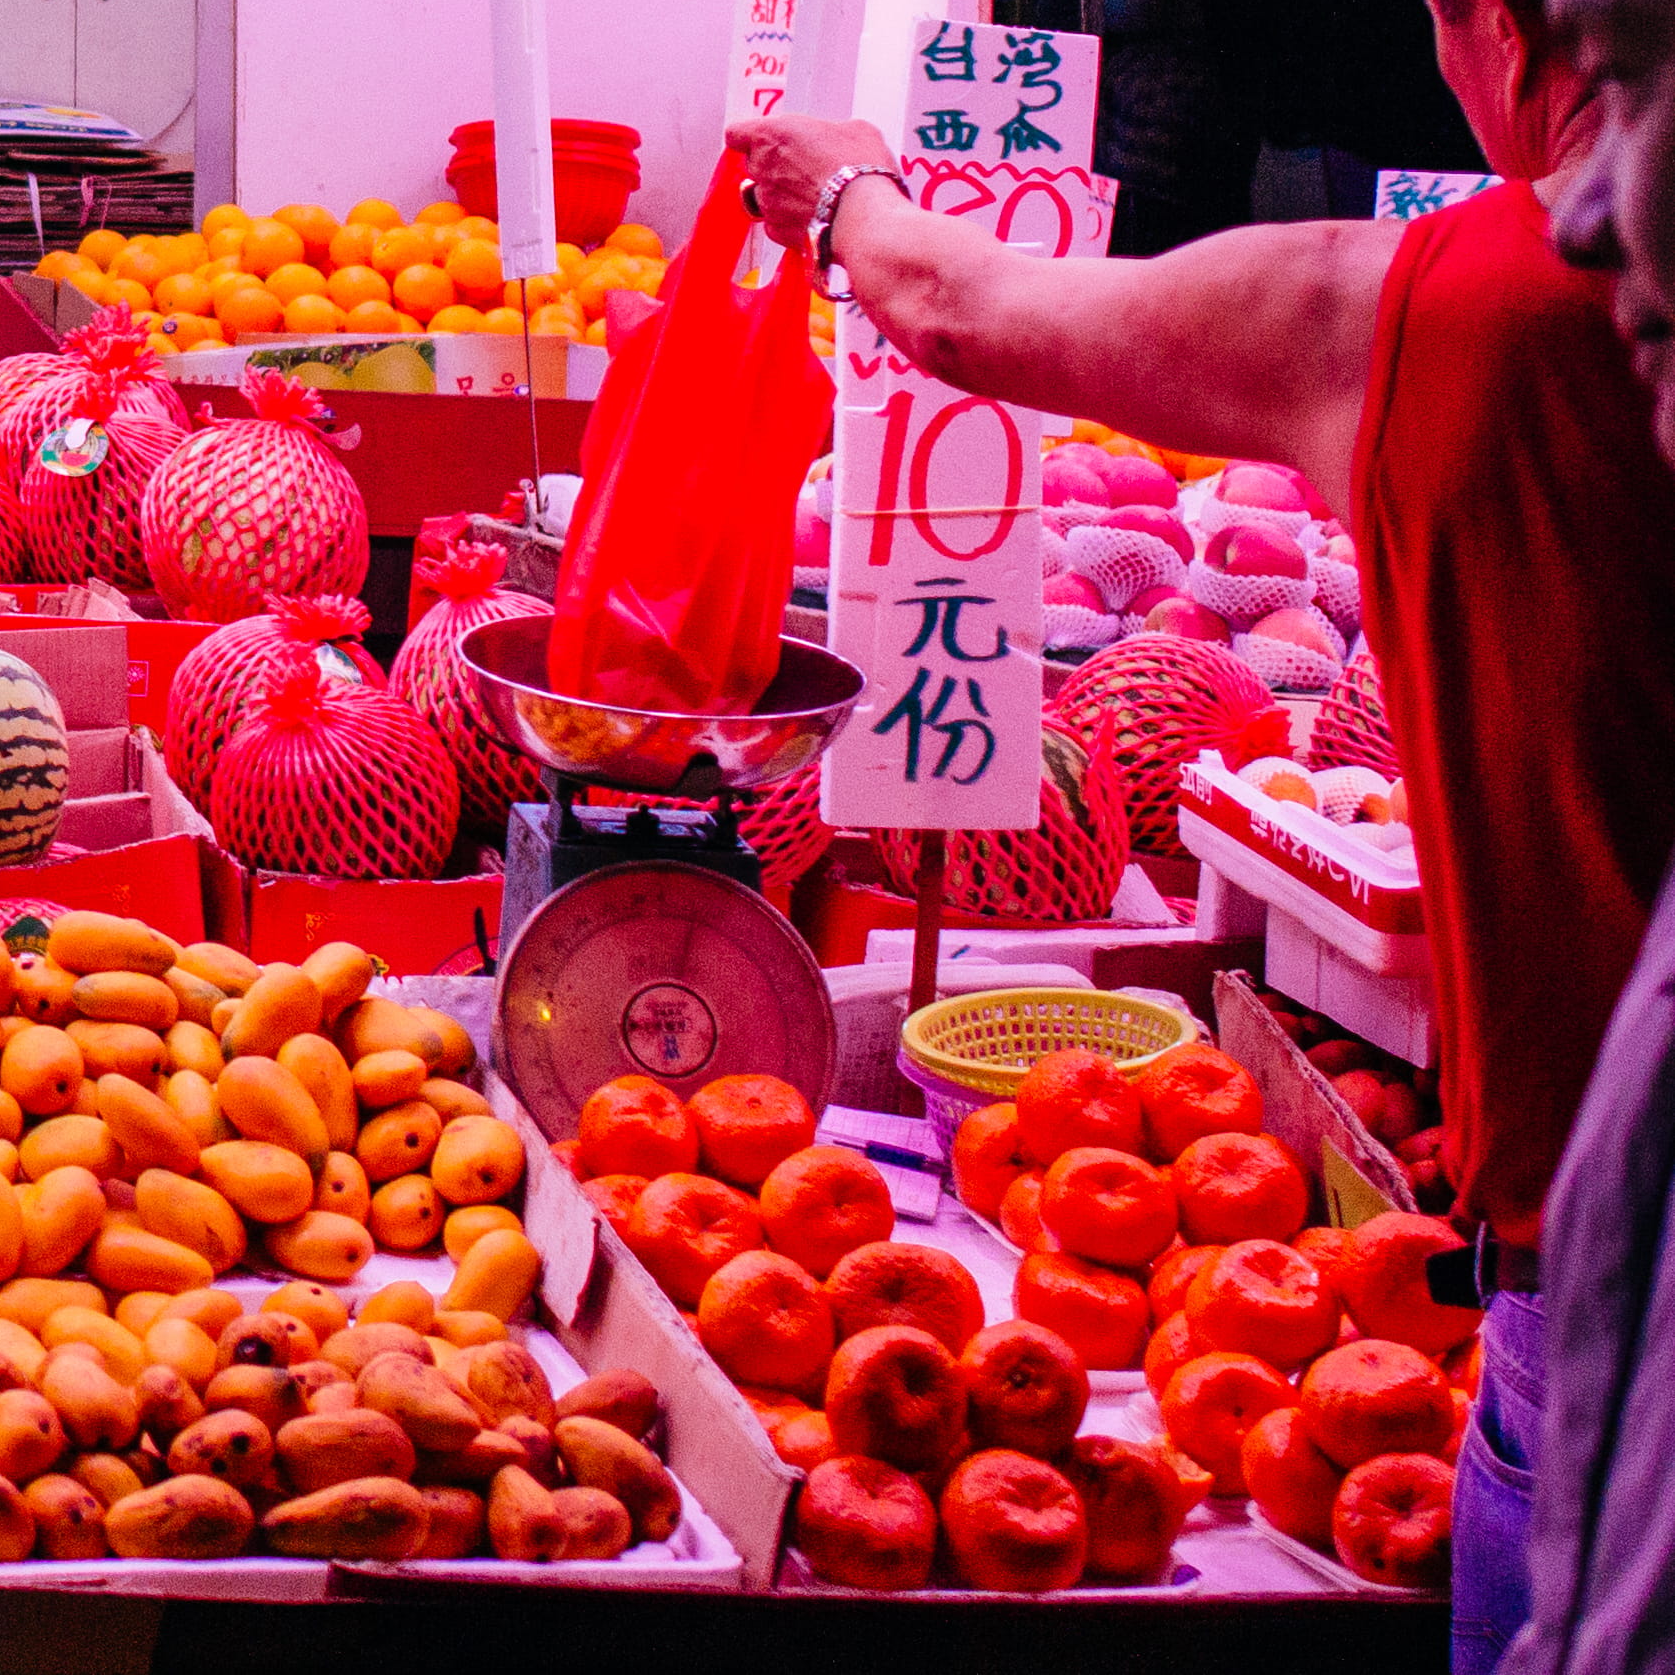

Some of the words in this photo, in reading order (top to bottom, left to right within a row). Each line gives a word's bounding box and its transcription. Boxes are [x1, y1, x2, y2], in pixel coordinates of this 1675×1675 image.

[753, 87, 785, 117] 7
[921, 22, 1063, 114] 台湾
[915, 109, 1063, 160] 西瓜
[870, 390, 1022, 567] 10
